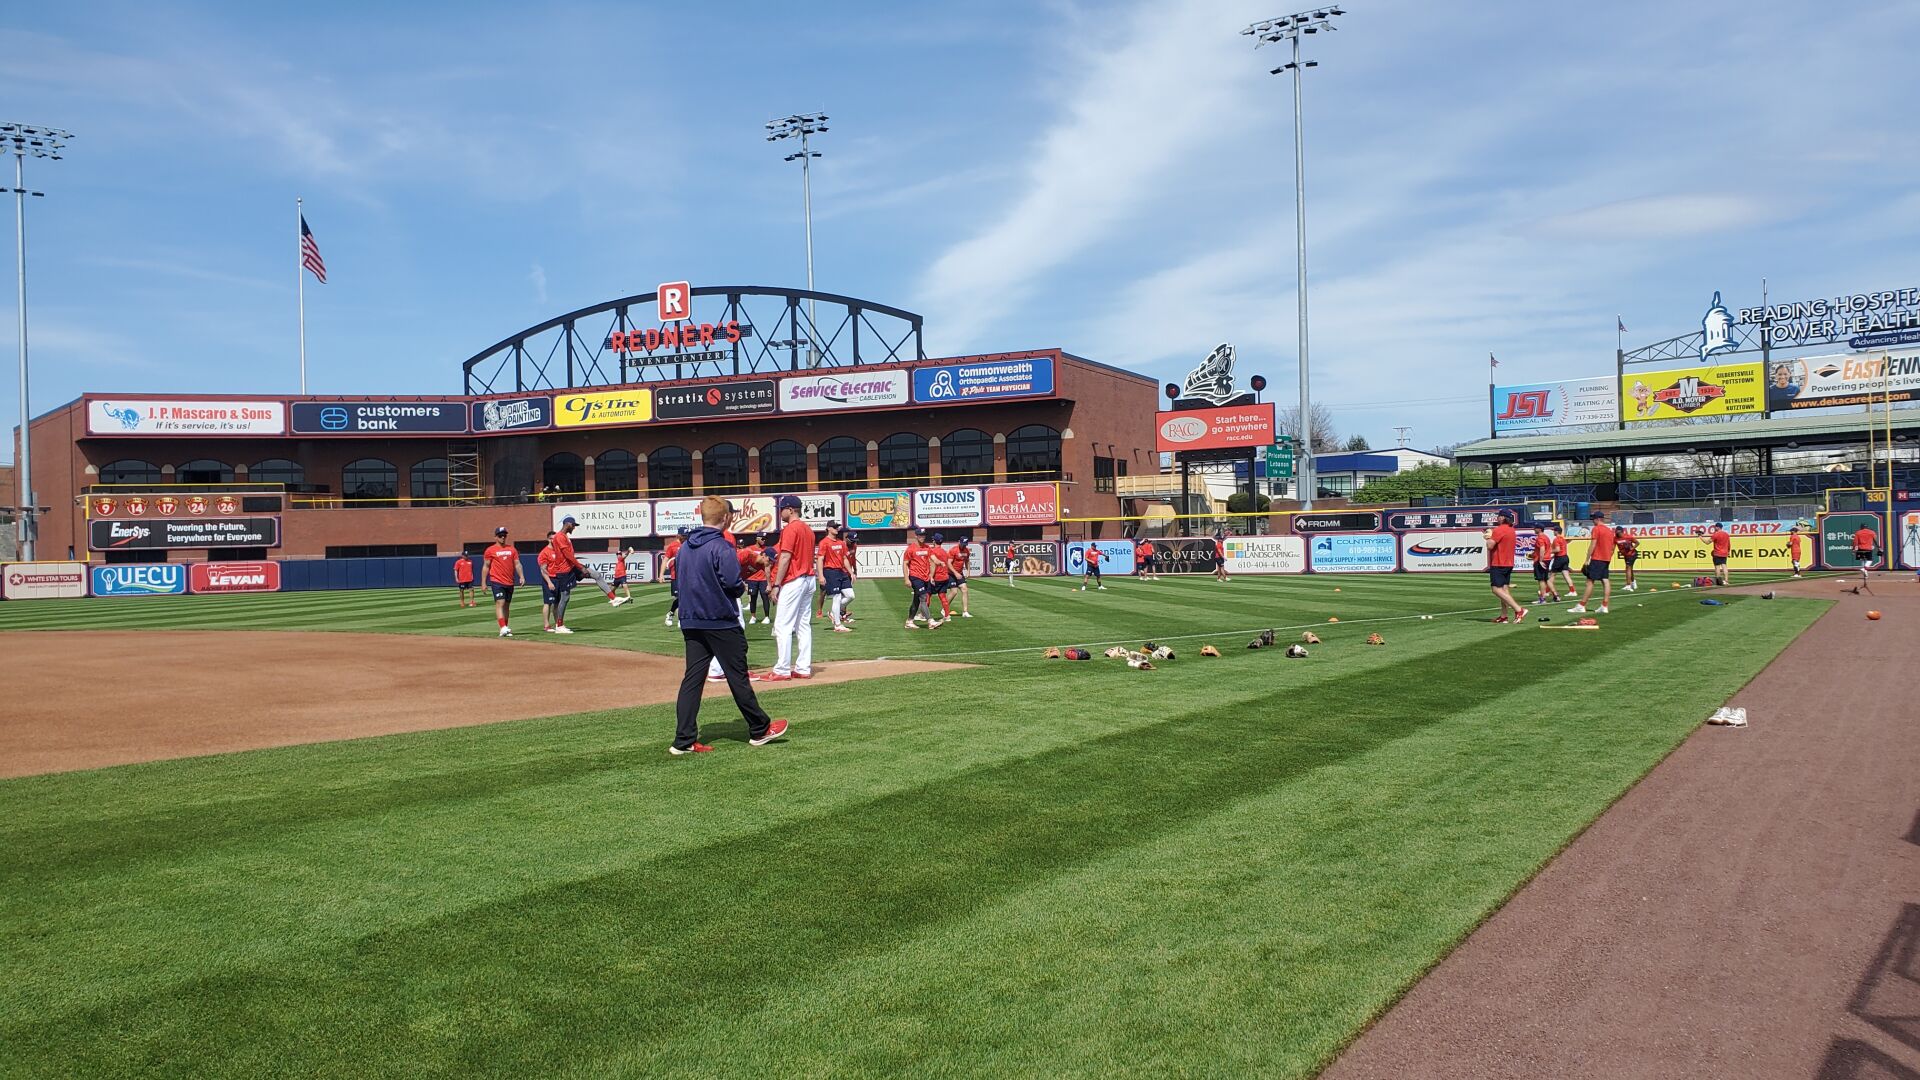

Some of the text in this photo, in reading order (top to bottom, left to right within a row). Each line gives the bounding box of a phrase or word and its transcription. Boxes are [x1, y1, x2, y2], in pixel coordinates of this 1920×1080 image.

[665, 288, 683, 313] R
[1740, 299, 1828, 324] READING
[1760, 310, 1920, 342] TOWER HEALTH
[612, 320, 740, 353] REDNER'S
[1854, 336, 1898, 347] Advancing
[631, 351, 721, 366] EVENT CENTER
[959, 363, 1032, 377] Commonwealth
[1716, 370, 1754, 378] GILBERTSVILLE
[959, 374, 1032, 386] Orthopaedic Associates
[1811, 377, 1920, 393] Powering people's live
[791, 380, 893, 399] SERVICE ELECTRIC
[986, 385, 1000, 393] TEAM
[1002, 383, 1030, 391] PHYSICIAN
[1678, 379, 1699, 397] M
[658, 389, 773, 406] stratix systems
[859, 394, 897, 402] CABLEVISION
[1790, 392, 1911, 409] www.dekacareers.com
[508, 402, 528, 415] DAVIS
[604, 399, 640, 409] Tire
[149, 408, 272, 420] J. P. Mascaro & Sons
[357, 406, 440, 417] customers
[507, 408, 540, 425] PAINTING
[599, 410, 636, 418] AUTOMOTIVE
[358, 418, 398, 430] bank
[1215, 414, 1266, 424] Start here...
[182, 422, 217, 430] service,
[1168, 421, 1199, 439] RACC
[1211, 422, 1268, 434] go anywhere
[920, 491, 975, 504] VISIONS
[1866, 492, 1886, 502] 330
[102, 504, 110, 514] 9
[130, 504, 144, 514] 14
[162, 503, 172, 513] 17
[192, 503, 204, 513] 24
[220, 502, 234, 512] 26
[849, 498, 895, 516] UNIQUE
[989, 502, 1054, 514] BACHMAN'S
[581, 512, 615, 520] SPRING
[617, 510, 648, 520] RIDGE
[110, 522, 150, 538] EnerSys
[167, 522, 246, 533] Powering the Future,
[1731, 523, 1782, 534] PARTY
[168, 534, 213, 544] Everywhere
[226, 533, 262, 543] Everyone
[1022, 544, 1052, 553] CREEK
[1246, 543, 1282, 552] HALTER
[1664, 550, 1689, 558] DAY
[1694, 550, 1706, 558] IS
[1758, 548, 1790, 558] DAY.
[1244, 550, 1294, 558] LANDSCAPING
[1238, 560, 1290, 568] 610-404-4106
[118, 566, 176, 585] UECU
[210, 575, 266, 586] LEVAN
